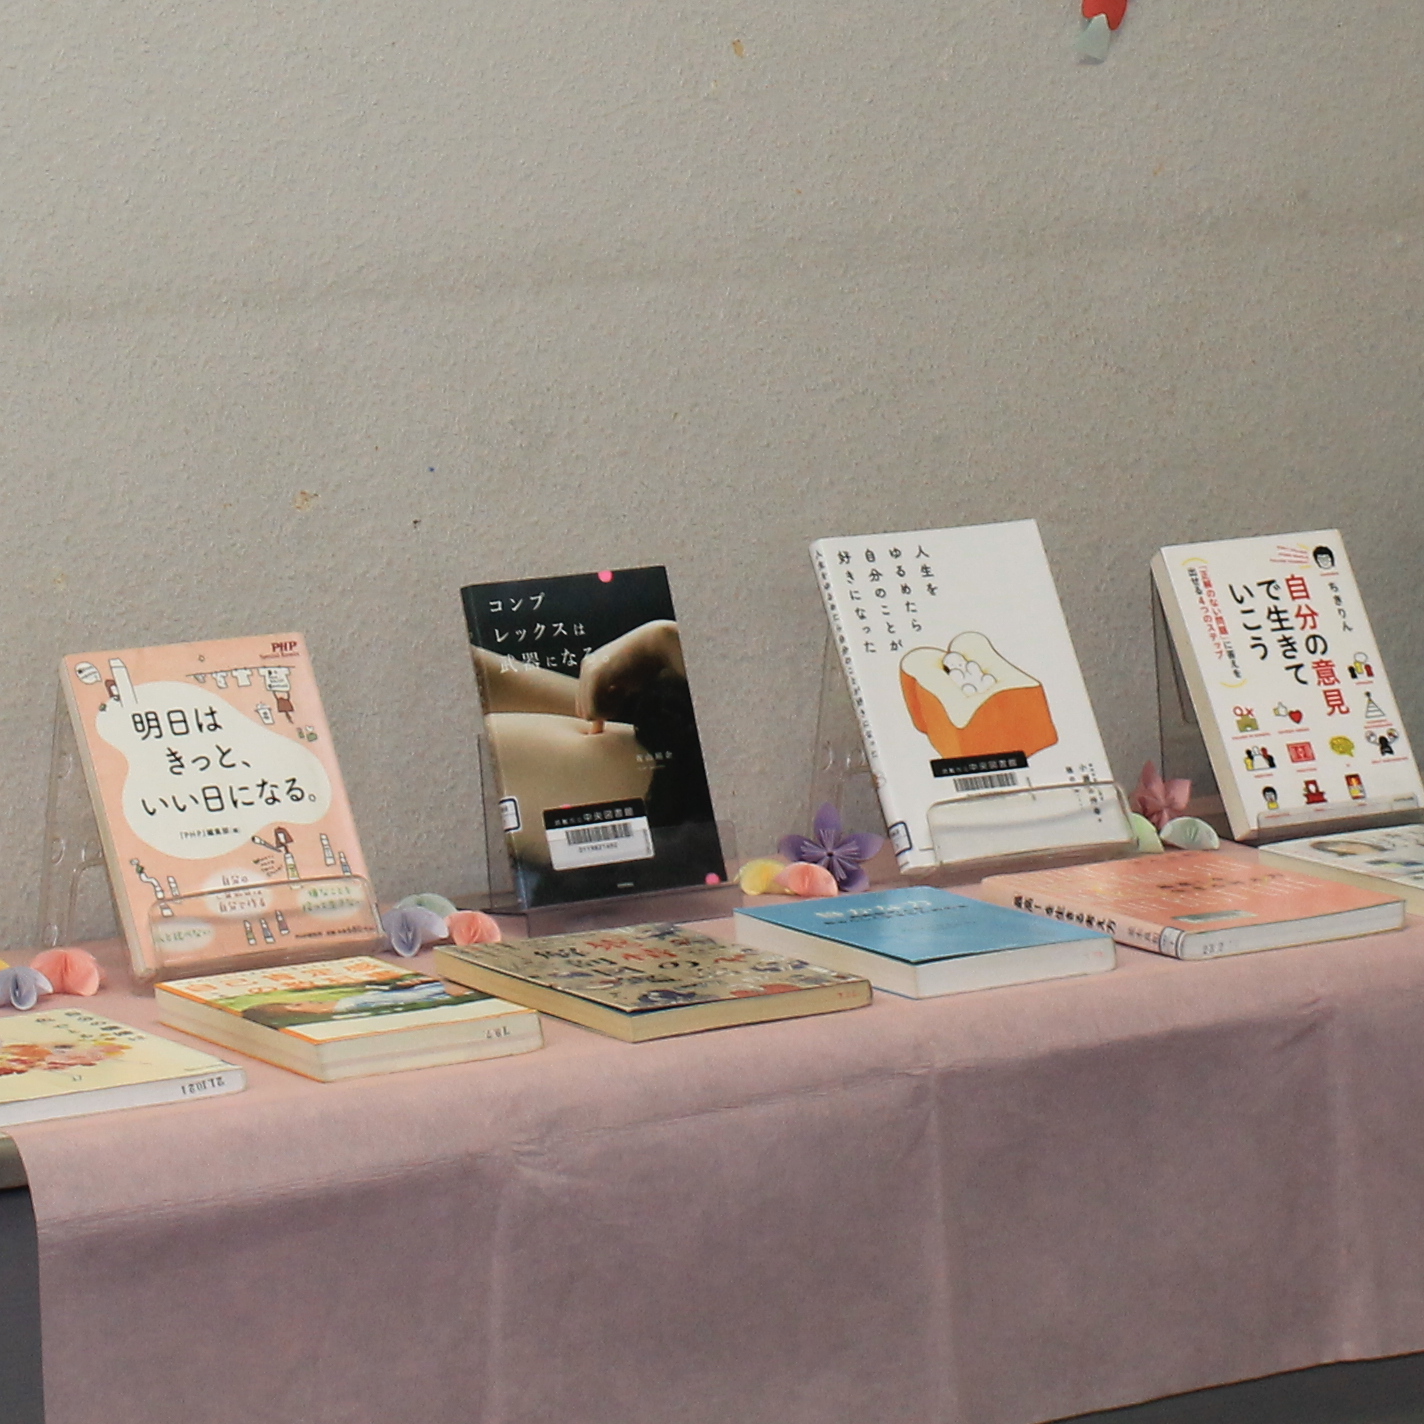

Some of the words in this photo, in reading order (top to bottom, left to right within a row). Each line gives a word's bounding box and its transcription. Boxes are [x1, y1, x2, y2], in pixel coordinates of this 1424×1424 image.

[889, 547, 922, 633] ゆるめたら
[915, 544, 939, 597] 人生を
[488, 591, 546, 613] コンプ
[837, 549, 876, 653] 好きになった
[864, 547, 904, 652] 自分のことが
[1228, 582, 1270, 662] いこう
[1328, 581, 1354, 632] ちきりん
[271, 640, 298, 652] PHP
[494, 621, 586, 644] レックスは
[1256, 577, 1309, 686] で生きて
[1285, 573, 1350, 717] 自分の意見
[131, 705, 223, 740] 明日は
[166, 744, 252, 776] きっと、
[140, 776, 317, 817] いい日になる。
